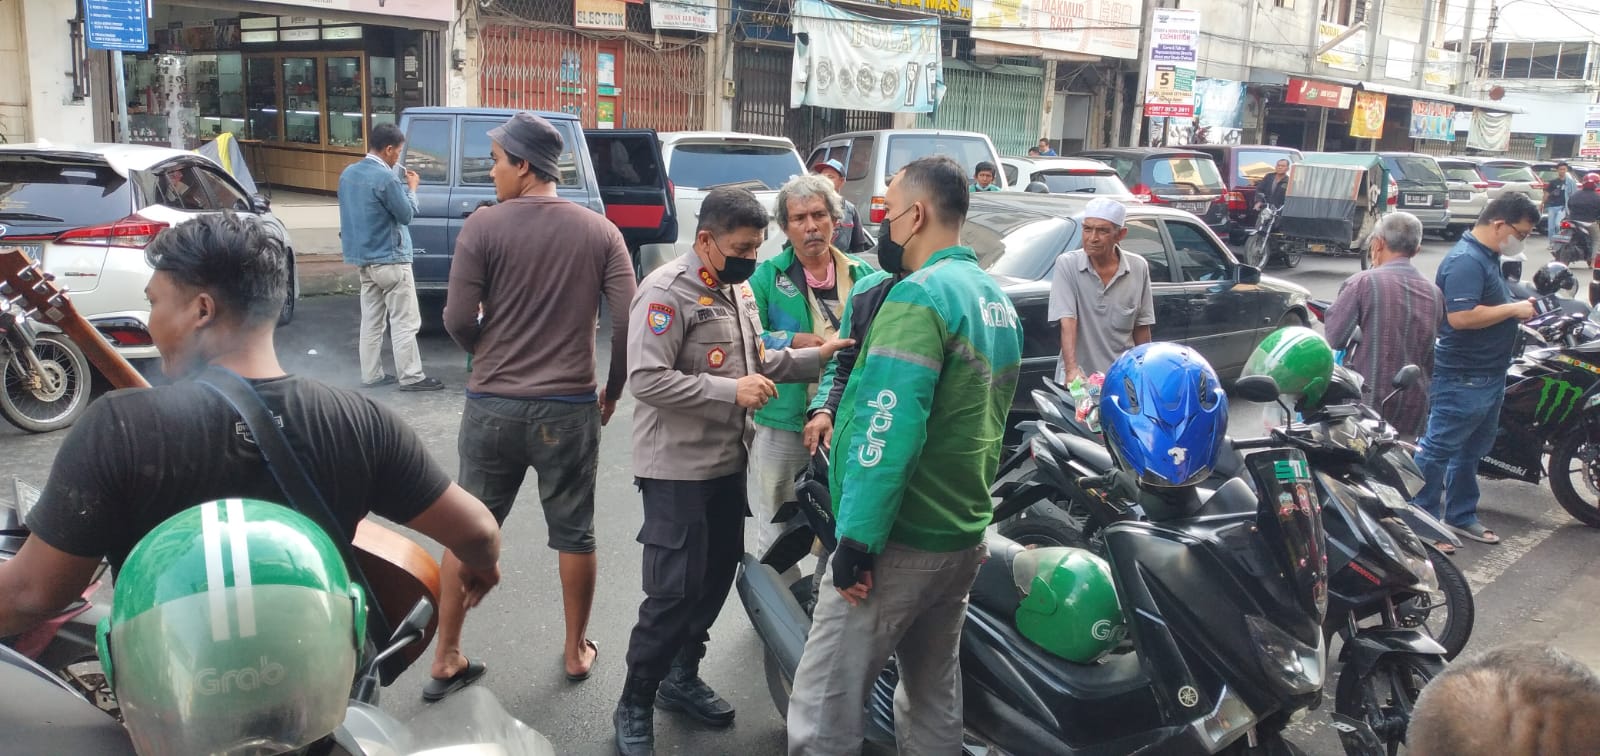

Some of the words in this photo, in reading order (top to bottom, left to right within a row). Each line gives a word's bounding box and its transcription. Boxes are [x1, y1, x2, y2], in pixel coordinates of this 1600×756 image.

[577, 10, 624, 26] ELECTRIK
[960, 8, 971, 18] 73
[1041, 0, 1084, 18] MAKMUR
[1050, 15, 1074, 33] RAYA
[1159, 72, 1170, 86] 5
[857, 389, 898, 468] Grab
[1480, 455, 1528, 476] awasaki
[1348, 561, 1381, 585] HONDA
[194, 655, 285, 696] Grab
